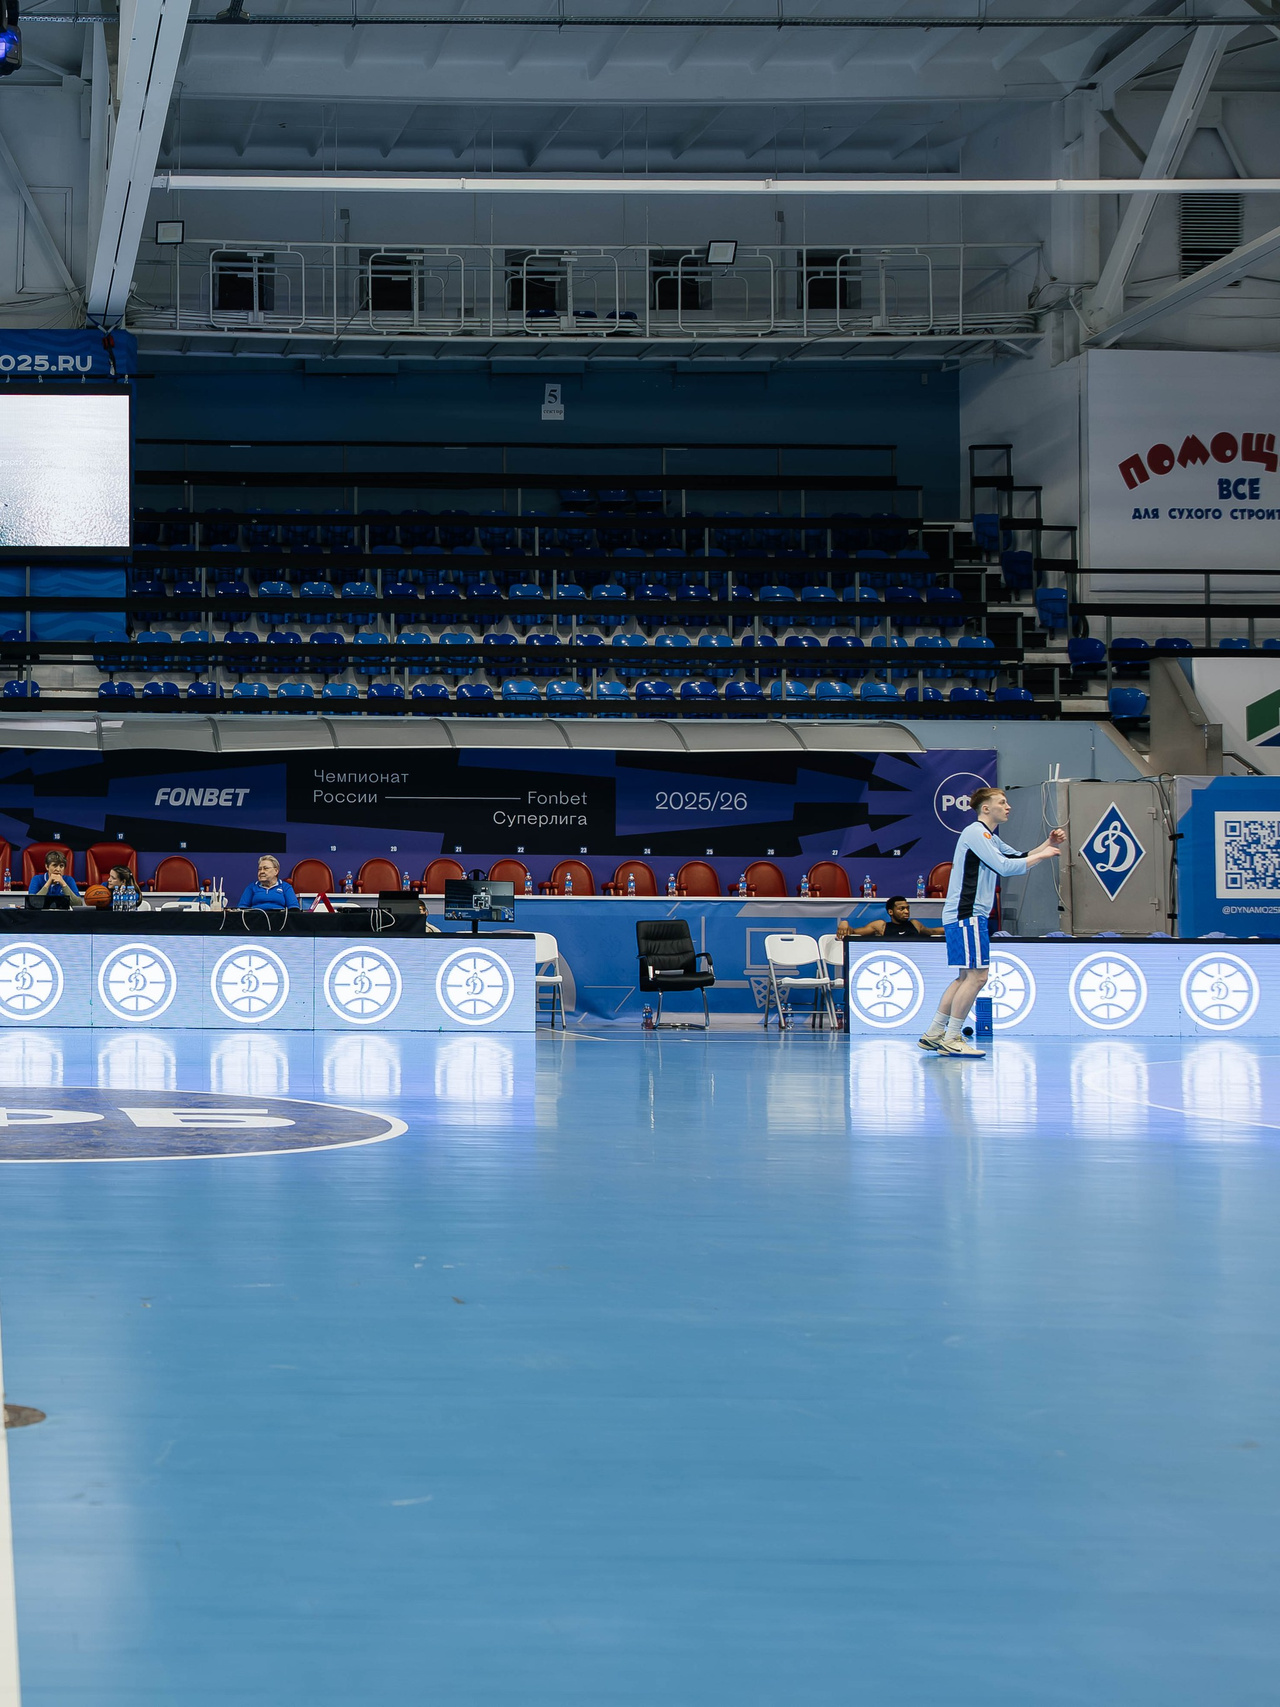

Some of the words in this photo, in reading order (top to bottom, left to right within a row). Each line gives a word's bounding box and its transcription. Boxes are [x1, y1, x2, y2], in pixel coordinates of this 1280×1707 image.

[547, 389, 558, 404] 5
[1118, 431, 1280, 490] ПОМОЩ
[1217, 477, 1261, 500] ВСЕ
[1131, 507, 1159, 520] ДЛЯ
[1168, 507, 1223, 520] СУХОГО
[314, 769, 409, 783] Чемпионат
[154, 787, 251, 807] FONBET
[313, 790, 378, 803] России
[527, 791, 588, 805] Fonbet
[655, 790, 748, 812] 2025/26
[942, 794, 972, 812] РФ
[493, 811, 588, 828] Суперлига
